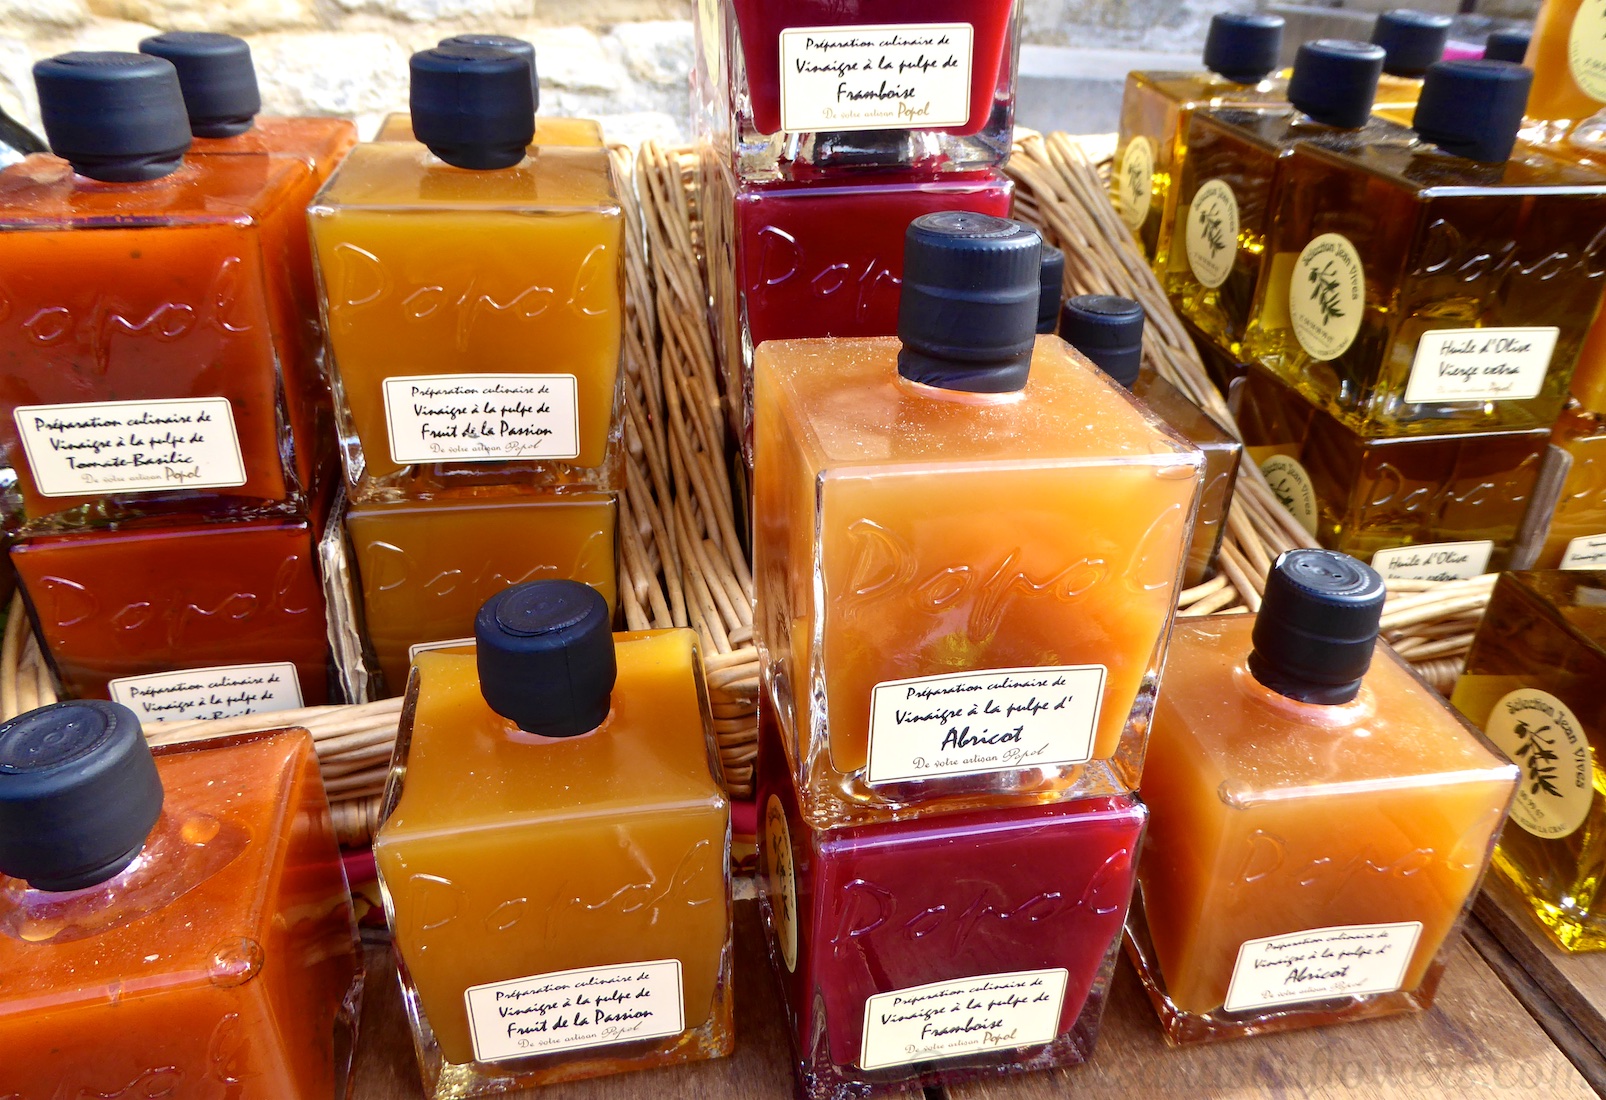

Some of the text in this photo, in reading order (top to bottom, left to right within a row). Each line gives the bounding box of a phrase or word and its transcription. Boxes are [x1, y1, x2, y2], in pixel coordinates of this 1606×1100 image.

[806, 35, 950, 52] Préparation culinaire de
[796, 54, 958, 77] Vinaigre à la pulpe de
[837, 81, 916, 103] Framboise
[822, 102, 930, 121] De votre artisan Popol
[1335, 243, 1351, 266] Jean
[1350, 265, 1358, 300] Vives
[1440, 338, 1532, 356] Huile d'Olive
[1438, 362, 1520, 382] Vierge extra
[412, 384, 550, 398] Préparation culinaire de
[35, 411, 212, 431] Préparation culinaire de
[414, 402, 550, 420] Vinaigre à la pulpe de
[422, 420, 553, 440] Fruit de la Passion
[50, 432, 204, 453] Vinaigre à la pulpe de
[430, 439, 542, 456] De votre artisan Popol
[66, 452, 193, 469] Tomate-Basilic
[82, 474, 99, 483] De
[165, 466, 202, 483] Popol
[1388, 552, 1470, 569] Huile d'Olive
[130, 673, 280, 698] Préparation culinaire de
[906, 676, 1067, 700] Préparation culinaire de
[142, 690, 274, 713] Vinaigre à la pulpe de
[896, 696, 1073, 725] Vinaigre à la pulpe d'
[941, 725, 1024, 751] Abricot
[912, 743, 1049, 770] De votre artisan Popol
[1554, 711, 1577, 745] Jean
[1573, 747, 1585, 788] Vives
[1266, 930, 1389, 951] Préparation culinaire de
[1254, 945, 1392, 969] Vinaigre à la pulpe d'
[496, 972, 649, 1001] Préparation culinaire de
[1284, 966, 1349, 985] Abricot
[499, 988, 650, 1018] Vinaigre à la pulpe de
[894, 978, 1043, 1006] Préparation culinaire de
[881, 992, 1050, 1025] Vinaigre à la pulpe de
[507, 1009, 653, 1038] Fruit de la Passion
[921, 1017, 1003, 1039] Framboise
[518, 1021, 643, 1049] De votre artisan Popol
[983, 1028, 1017, 1045] Popol
